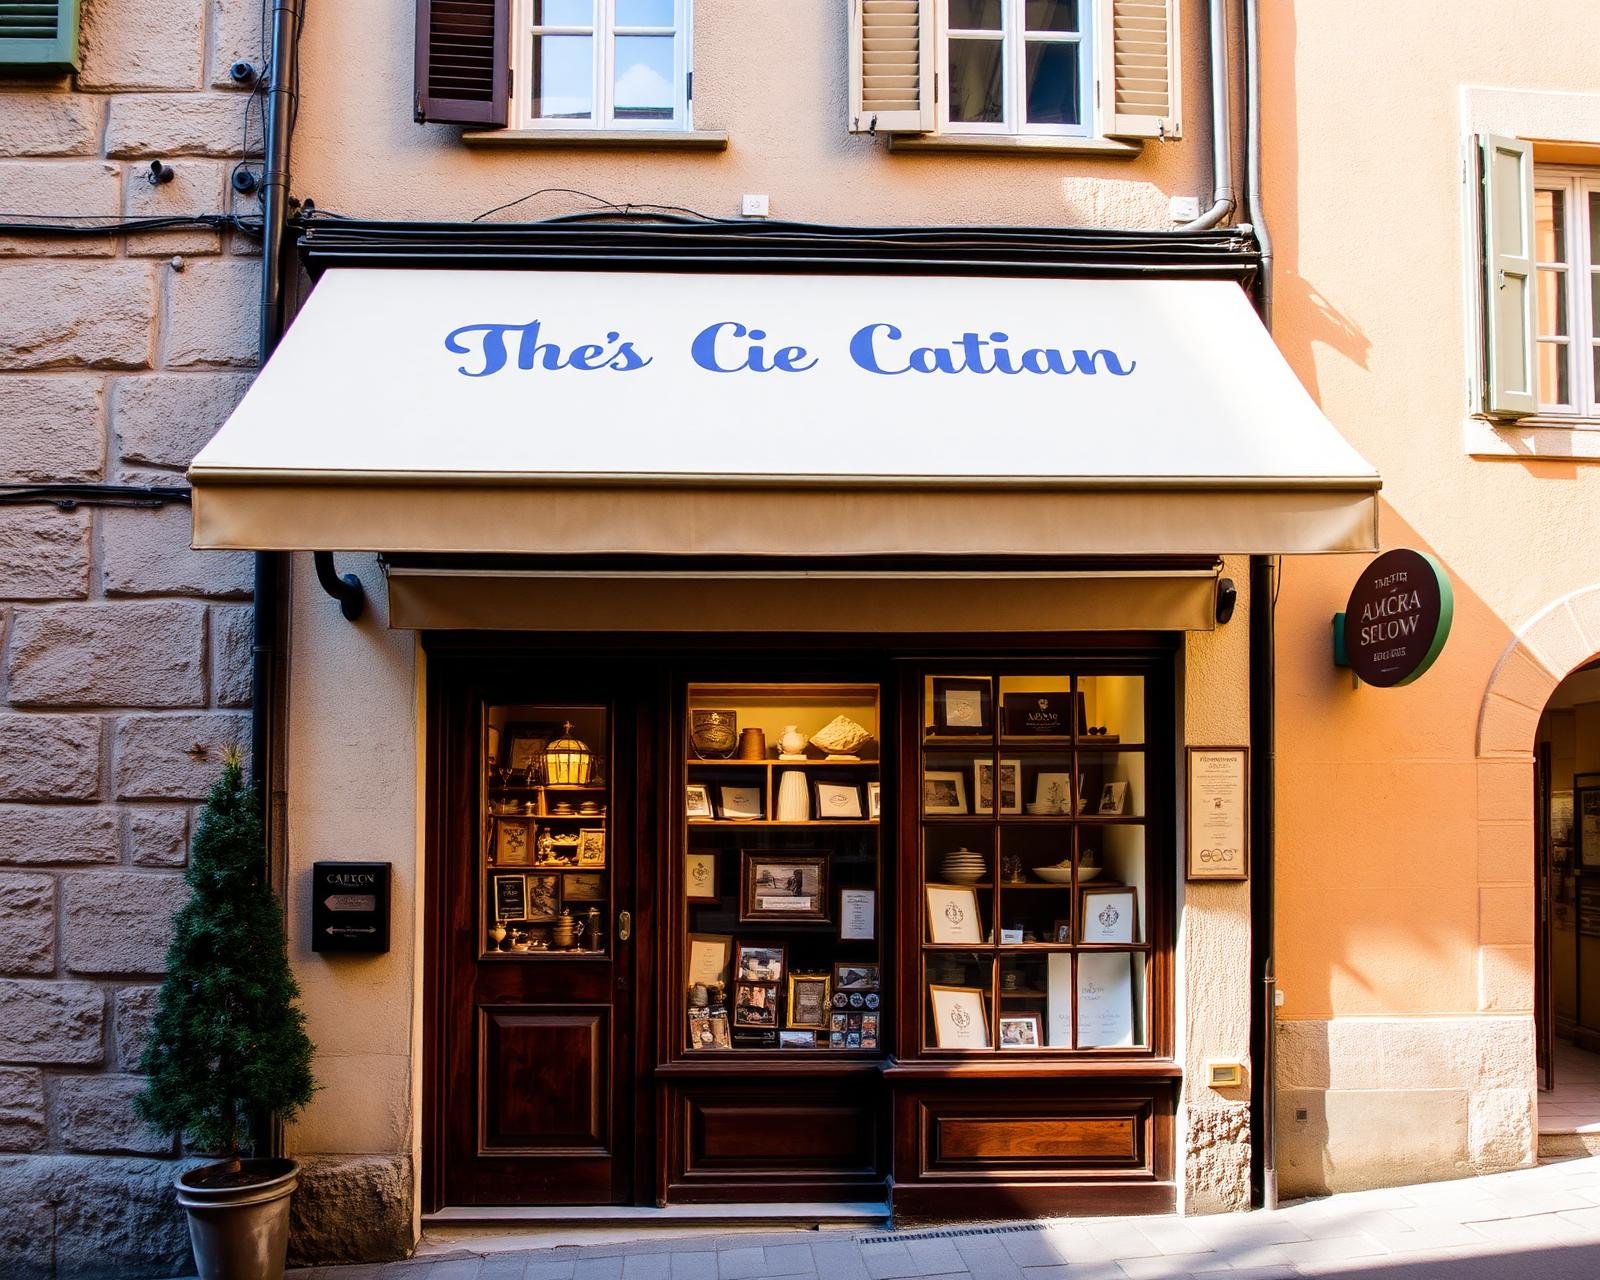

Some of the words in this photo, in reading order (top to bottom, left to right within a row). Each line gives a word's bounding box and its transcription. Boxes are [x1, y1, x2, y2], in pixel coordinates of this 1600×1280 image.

[443, 320, 653, 377] The's
[691, 321, 818, 374] Cie
[849, 323, 1136, 376] Catian
